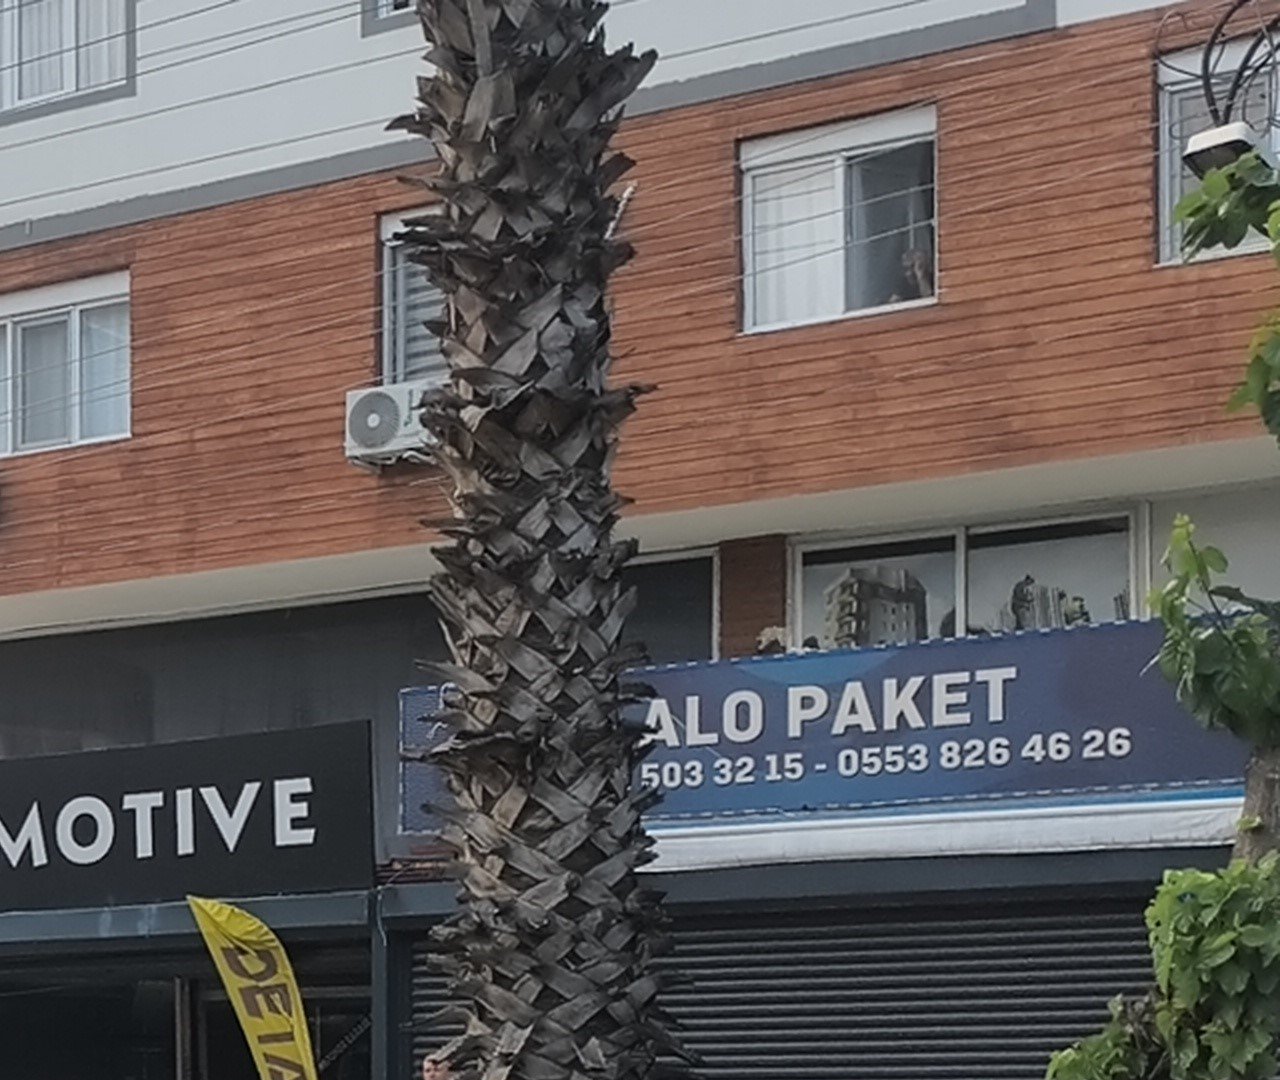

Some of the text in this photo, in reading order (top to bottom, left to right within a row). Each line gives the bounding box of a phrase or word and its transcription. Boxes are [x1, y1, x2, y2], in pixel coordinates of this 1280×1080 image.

[638, 666, 1018, 747] ALO PAKET
[641, 760, 704, 789] 503
[712, 756, 756, 786] 32
[765, 752, 804, 781] 15
[838, 743, 930, 777] 0553
[939, 737, 1011, 769] 826
[1020, 732, 1072, 762] 46
[1081, 727, 1132, 759] 26
